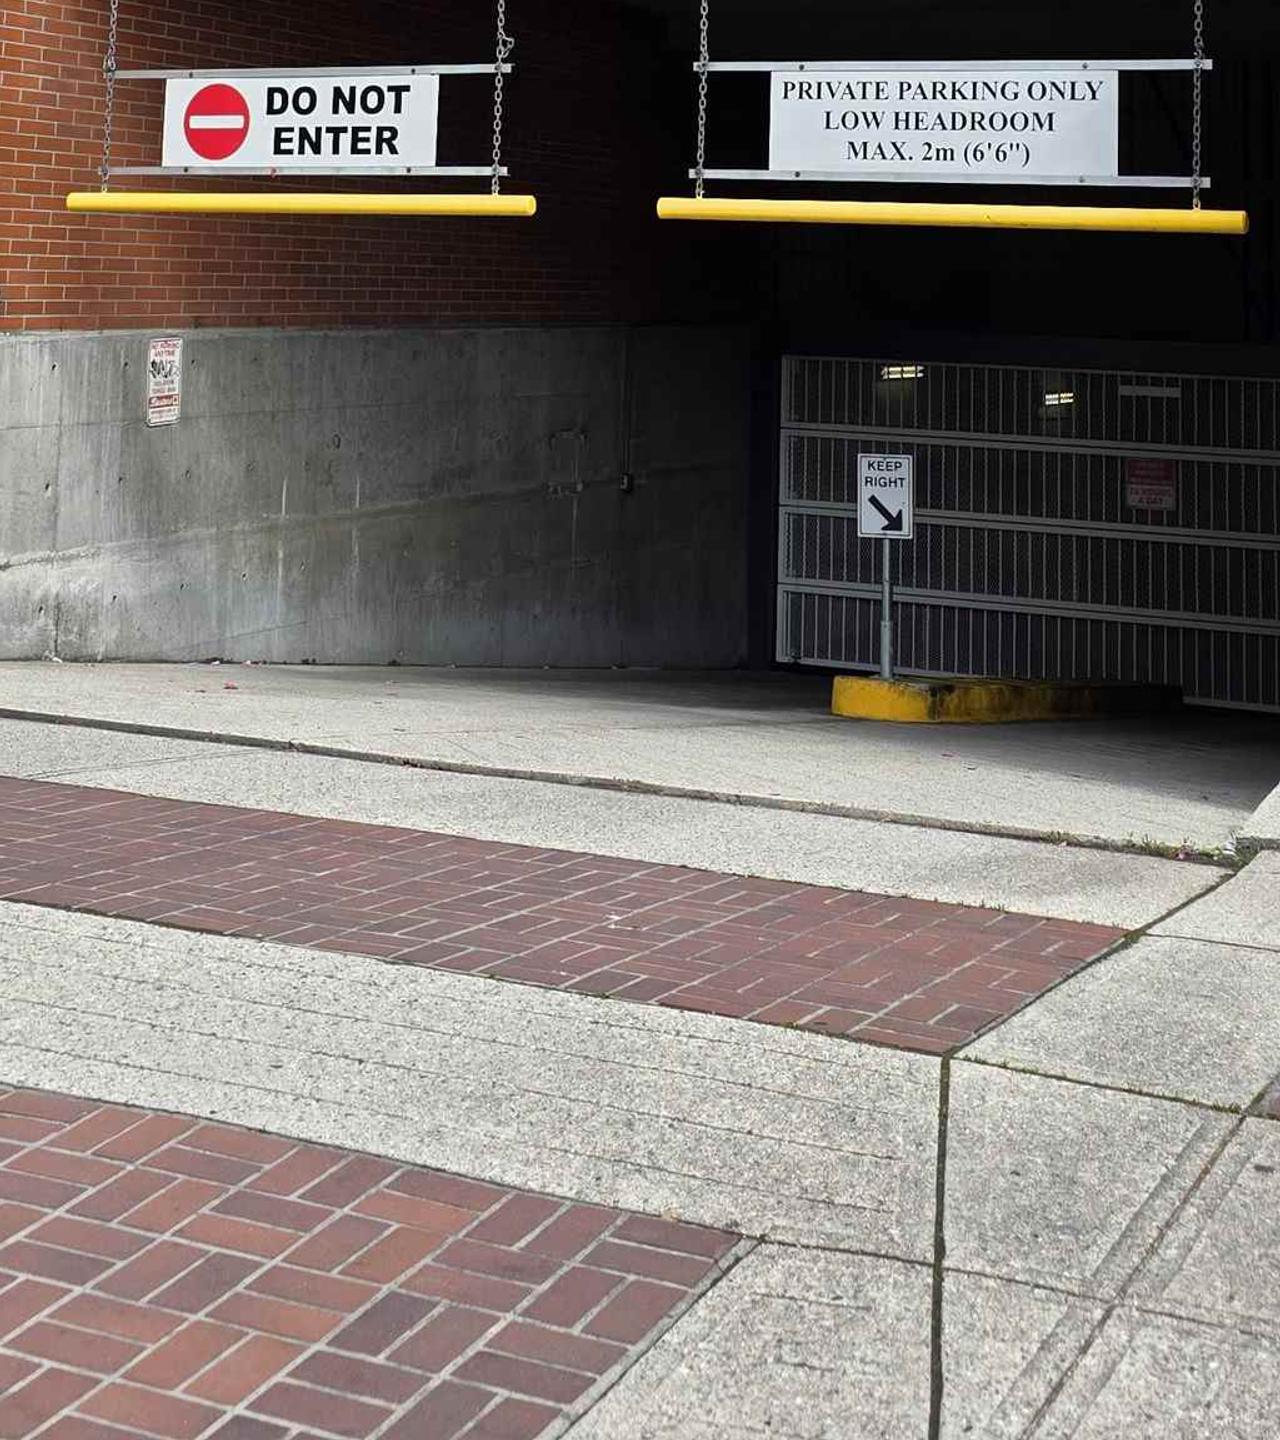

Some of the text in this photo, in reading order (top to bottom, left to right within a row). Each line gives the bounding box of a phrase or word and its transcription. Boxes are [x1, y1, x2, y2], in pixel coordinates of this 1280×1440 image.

[266, 84, 411, 116] DO NOT
[782, 80, 1104, 102] PRIVATE PARKING ONLY
[824, 111, 1056, 132] LOW HEADROOM
[273, 125, 400, 156] ENTER
[846, 140, 1031, 168] MAX. 2m (6'6")
[867, 460, 902, 471] KEEP
[864, 476, 905, 488] RIGHT
